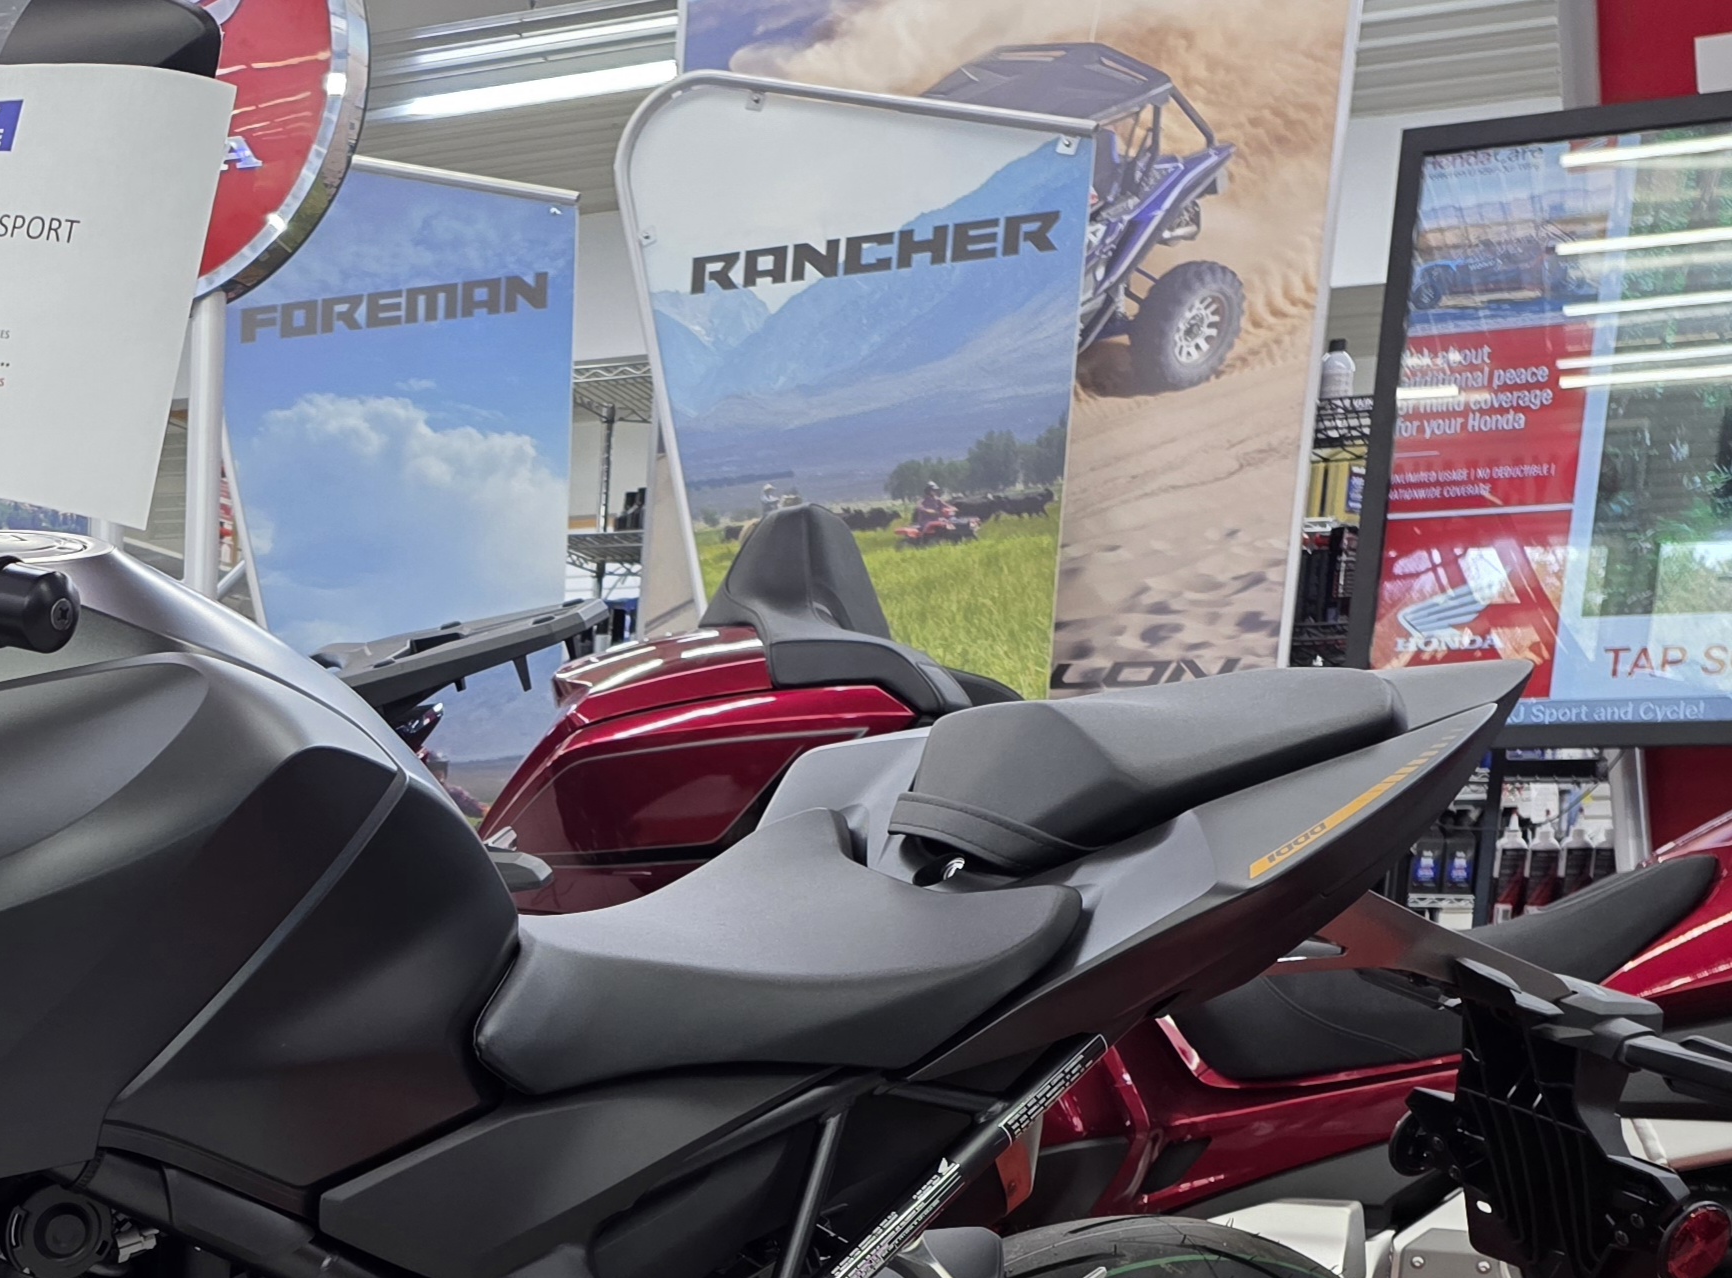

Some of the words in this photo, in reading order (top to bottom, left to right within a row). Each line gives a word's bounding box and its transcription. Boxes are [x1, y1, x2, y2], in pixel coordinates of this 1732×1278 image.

[690, 210, 1061, 295] RANCHER
[240, 271, 549, 344] FOREMAN
[1438, 345, 1491, 365] about
[1493, 366, 1549, 389] peace
[1468, 388, 1553, 410] coverage
[1424, 418, 1465, 439] your
[1468, 409, 1525, 432] Honda
[1394, 633, 1505, 652] HONDA
[1604, 645, 1688, 679] TAP
[1531, 704, 1588, 725] Sport
[1593, 701, 1633, 721] and
[1639, 699, 1705, 722] Cycle!
